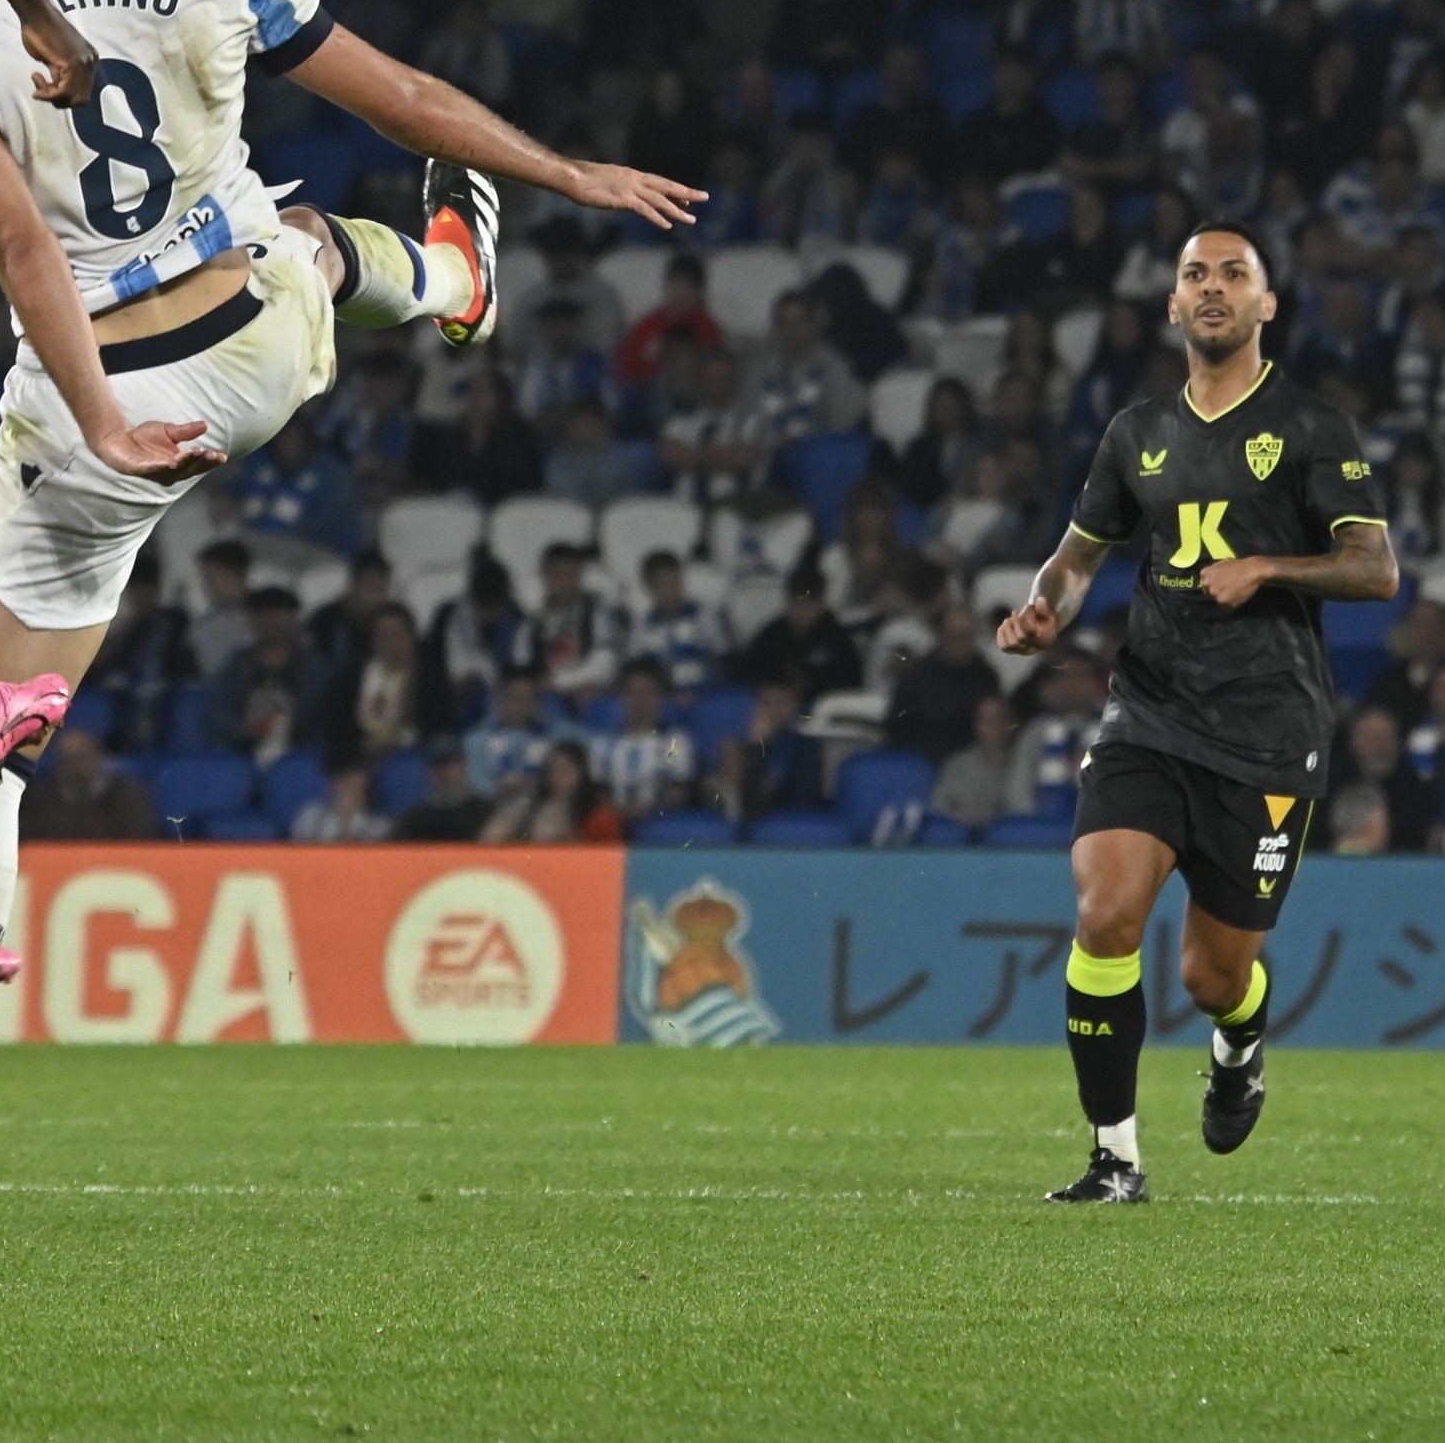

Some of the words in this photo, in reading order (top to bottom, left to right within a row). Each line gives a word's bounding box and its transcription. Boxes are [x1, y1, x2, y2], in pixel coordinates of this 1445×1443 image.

[72, 57, 177, 240] 8
[1169, 500, 1236, 568] JK
[419, 913, 530, 977] EA
